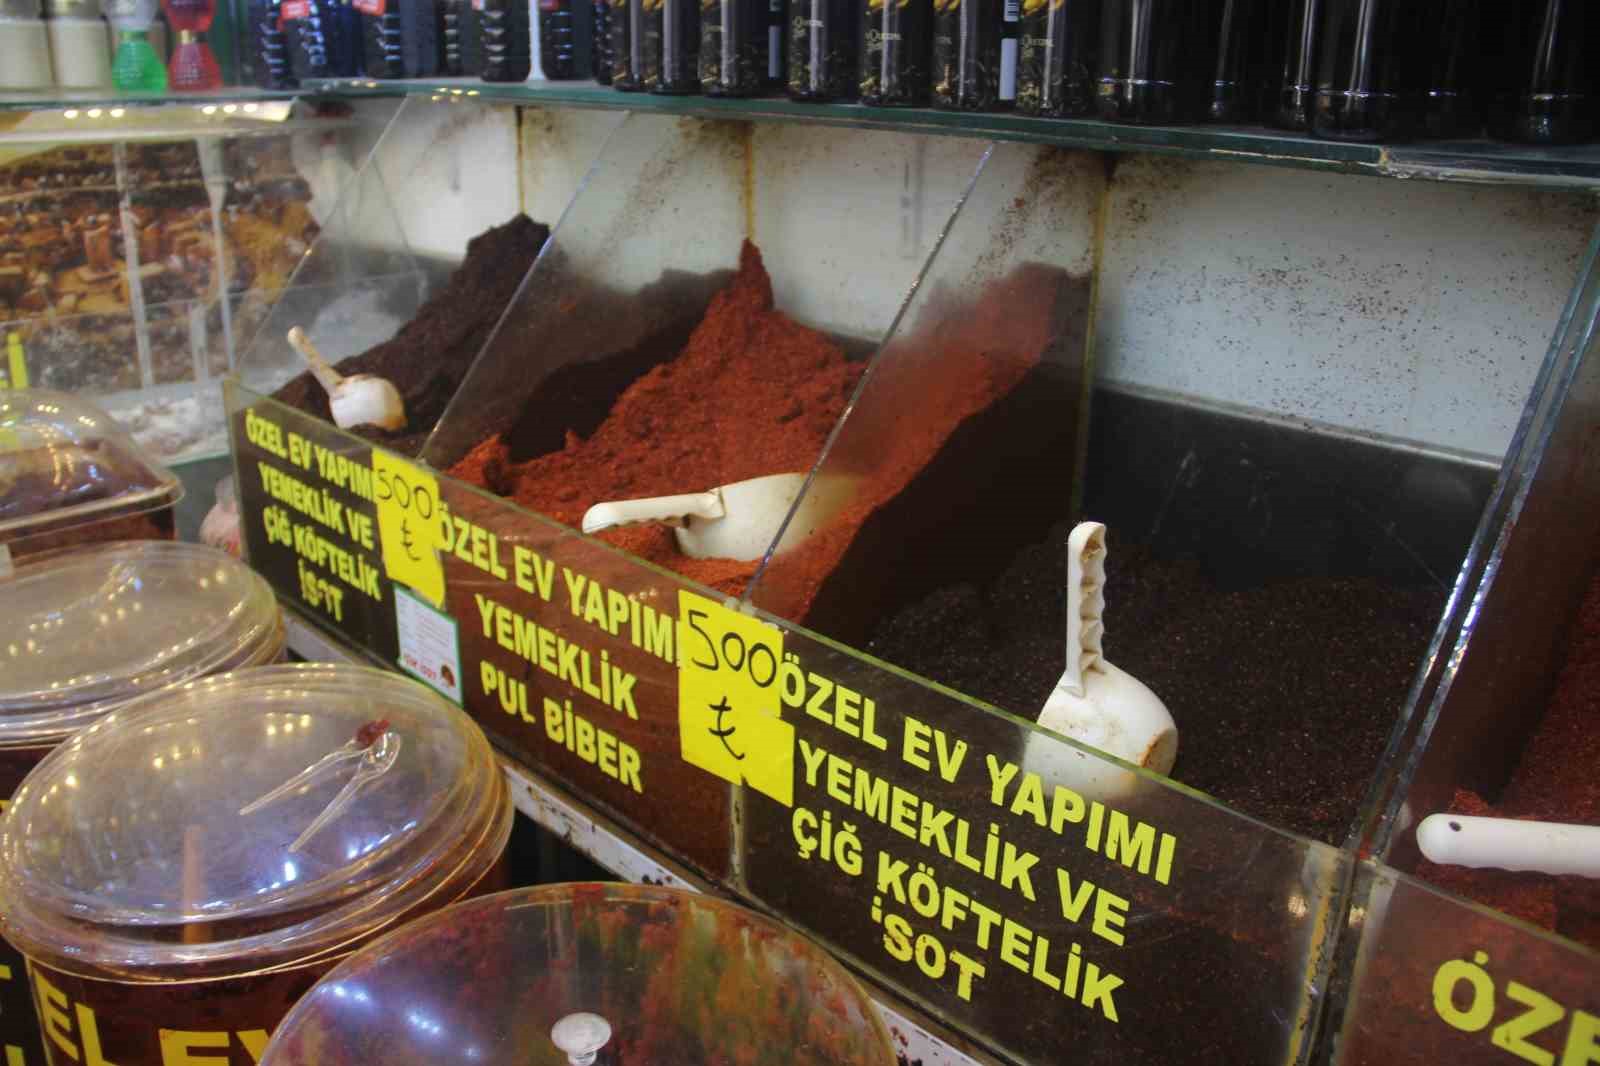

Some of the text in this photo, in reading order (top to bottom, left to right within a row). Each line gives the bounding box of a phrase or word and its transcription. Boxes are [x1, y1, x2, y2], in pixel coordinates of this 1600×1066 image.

[245, 408, 288, 459] ÖZEL
[288, 432, 313, 470] EV
[257, 461, 374, 550] YEMEKLİK VE
[376, 468, 433, 520] 500
[294, 525, 382, 601] KÖFTELİK
[438, 502, 507, 581] ÖZEL
[514, 545, 555, 601] EV
[475, 593, 639, 721] YEMEKLİK
[688, 609, 777, 688] 500
[480, 660, 643, 794] PUL BİBER
[779, 651, 1177, 886] ÖZEL EV YAPIMI
[798, 738, 1130, 947] YEMEKLİK VE
[791, 806, 1125, 1023] ÇİĞ KÖFTELİK
[871, 894, 986, 1002] İSOT
